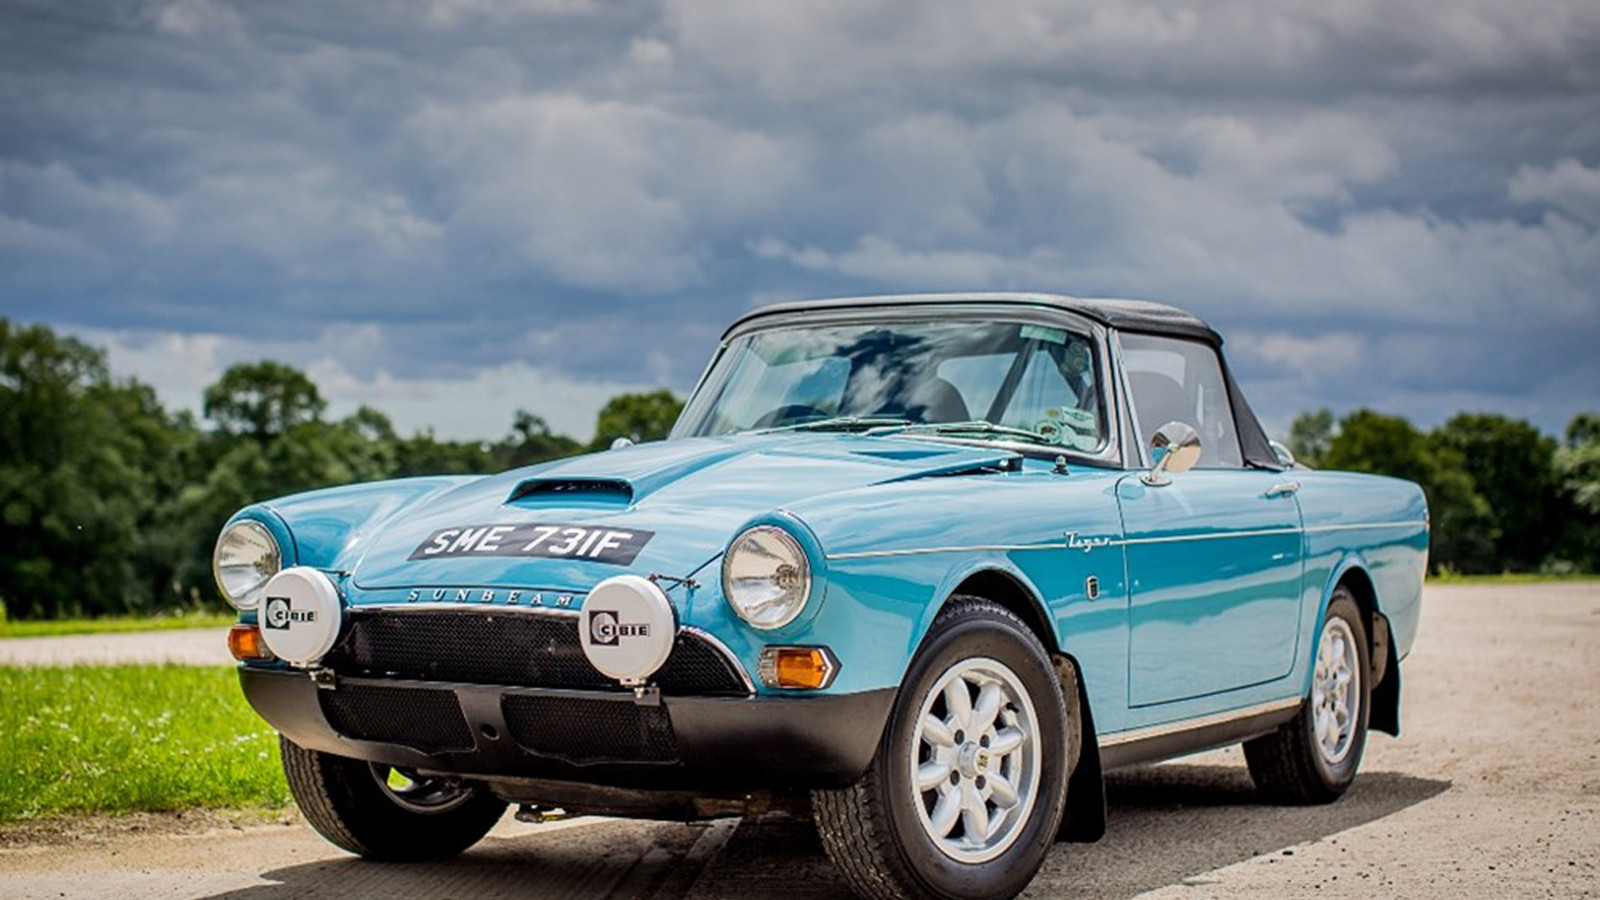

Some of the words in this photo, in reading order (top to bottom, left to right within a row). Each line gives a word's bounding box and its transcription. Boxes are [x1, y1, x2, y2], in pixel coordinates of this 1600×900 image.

[425, 526, 515, 554] SME
[524, 526, 632, 557] 731F
[407, 589, 573, 606] SUNBEAM
